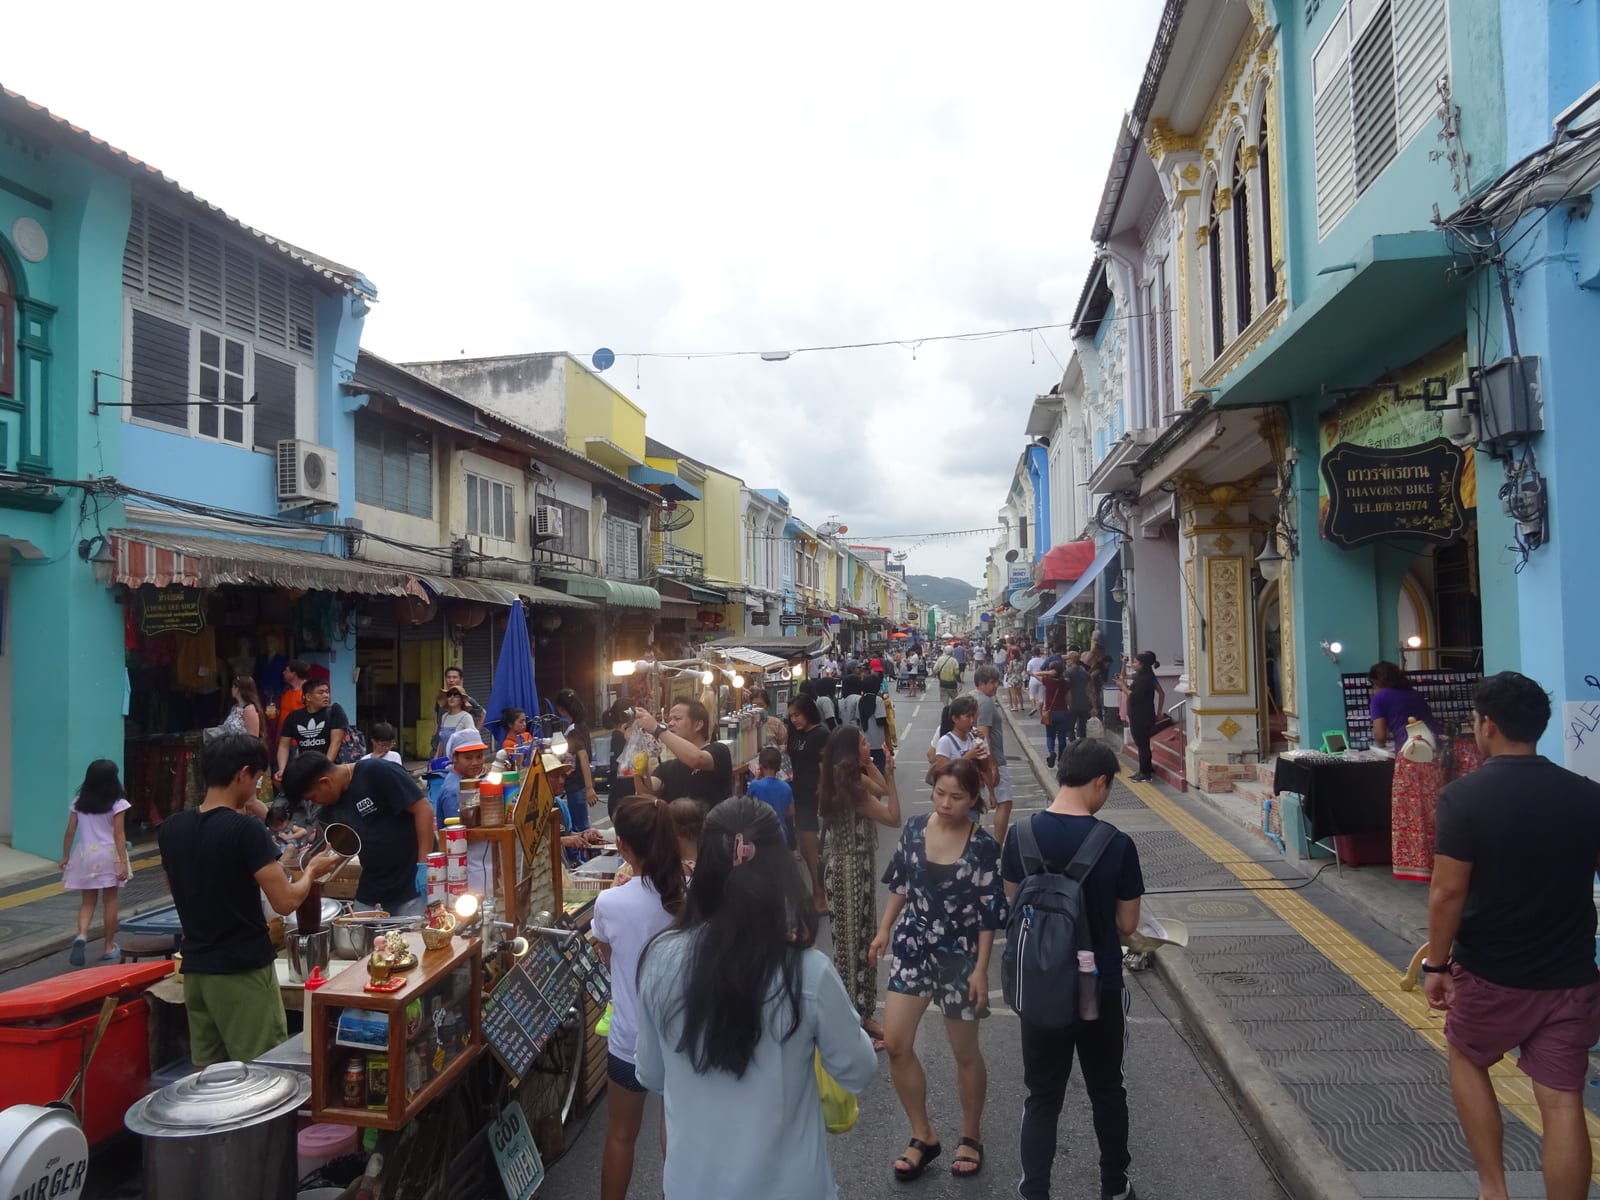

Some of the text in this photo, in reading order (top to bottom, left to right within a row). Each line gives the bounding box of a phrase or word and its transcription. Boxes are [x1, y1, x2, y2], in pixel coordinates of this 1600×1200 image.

[1347, 464, 1430, 481] ถาวรจักรยาน
[1345, 483, 1434, 497] THAVORN BIKE
[1395, 500, 1428, 511] 215774
[299, 738, 326, 747] adidas
[495, 1113, 521, 1153] GOD
[504, 1145, 541, 1200] WHEN
